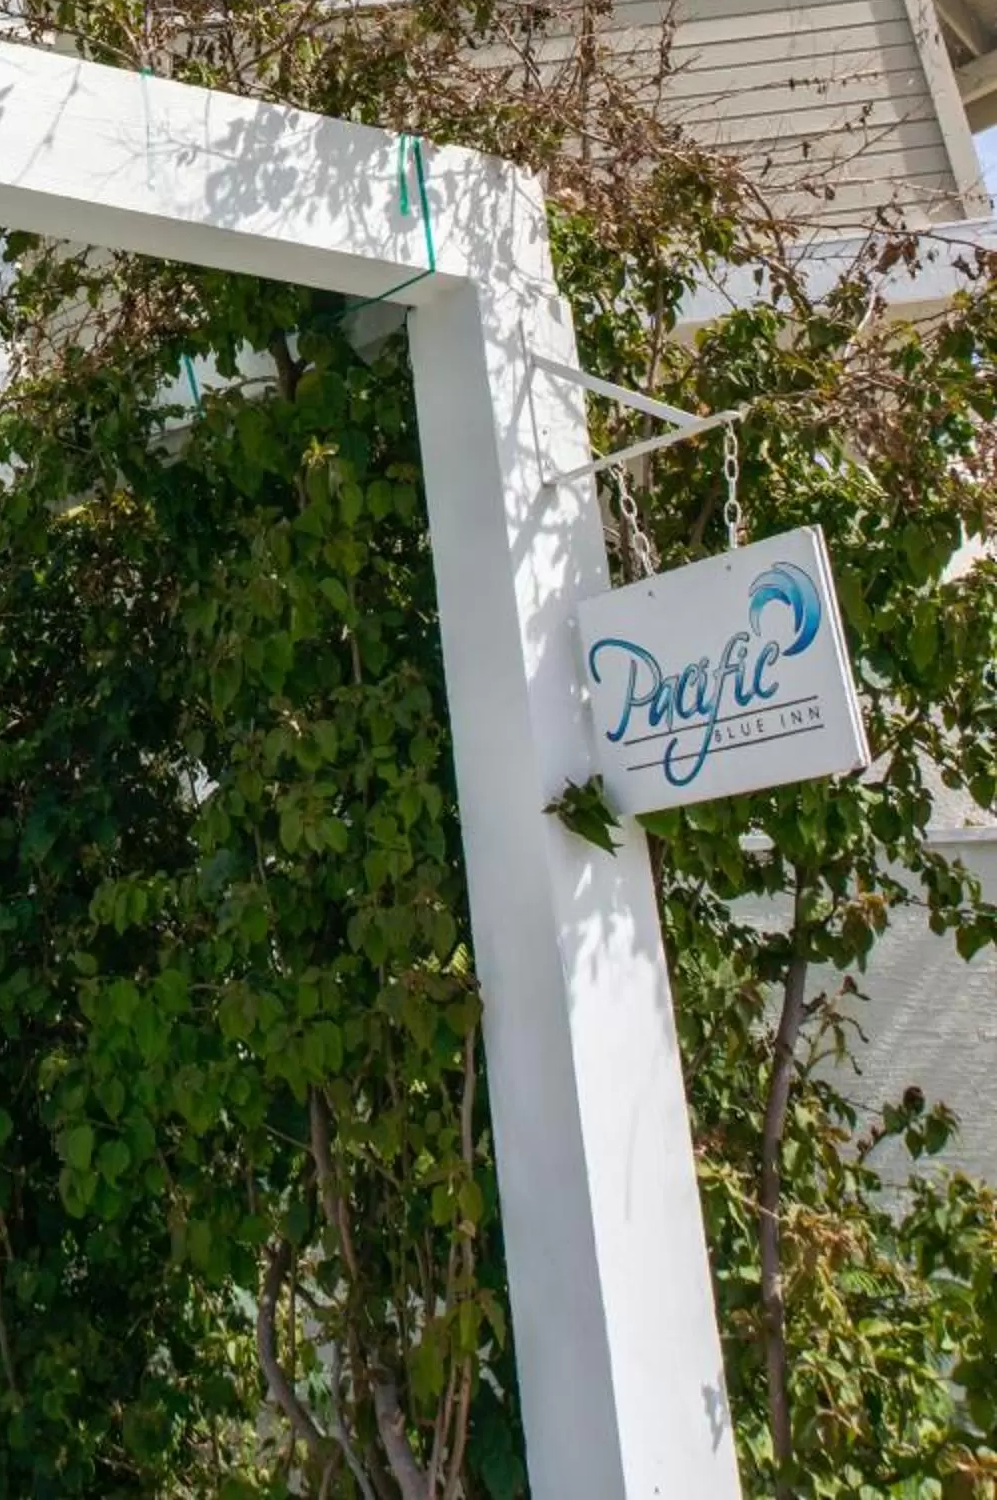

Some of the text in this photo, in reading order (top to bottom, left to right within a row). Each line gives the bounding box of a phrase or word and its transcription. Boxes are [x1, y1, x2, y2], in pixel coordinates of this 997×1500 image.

[589, 631, 780, 786] Pacific
[712, 704, 822, 744] BLUE INN
